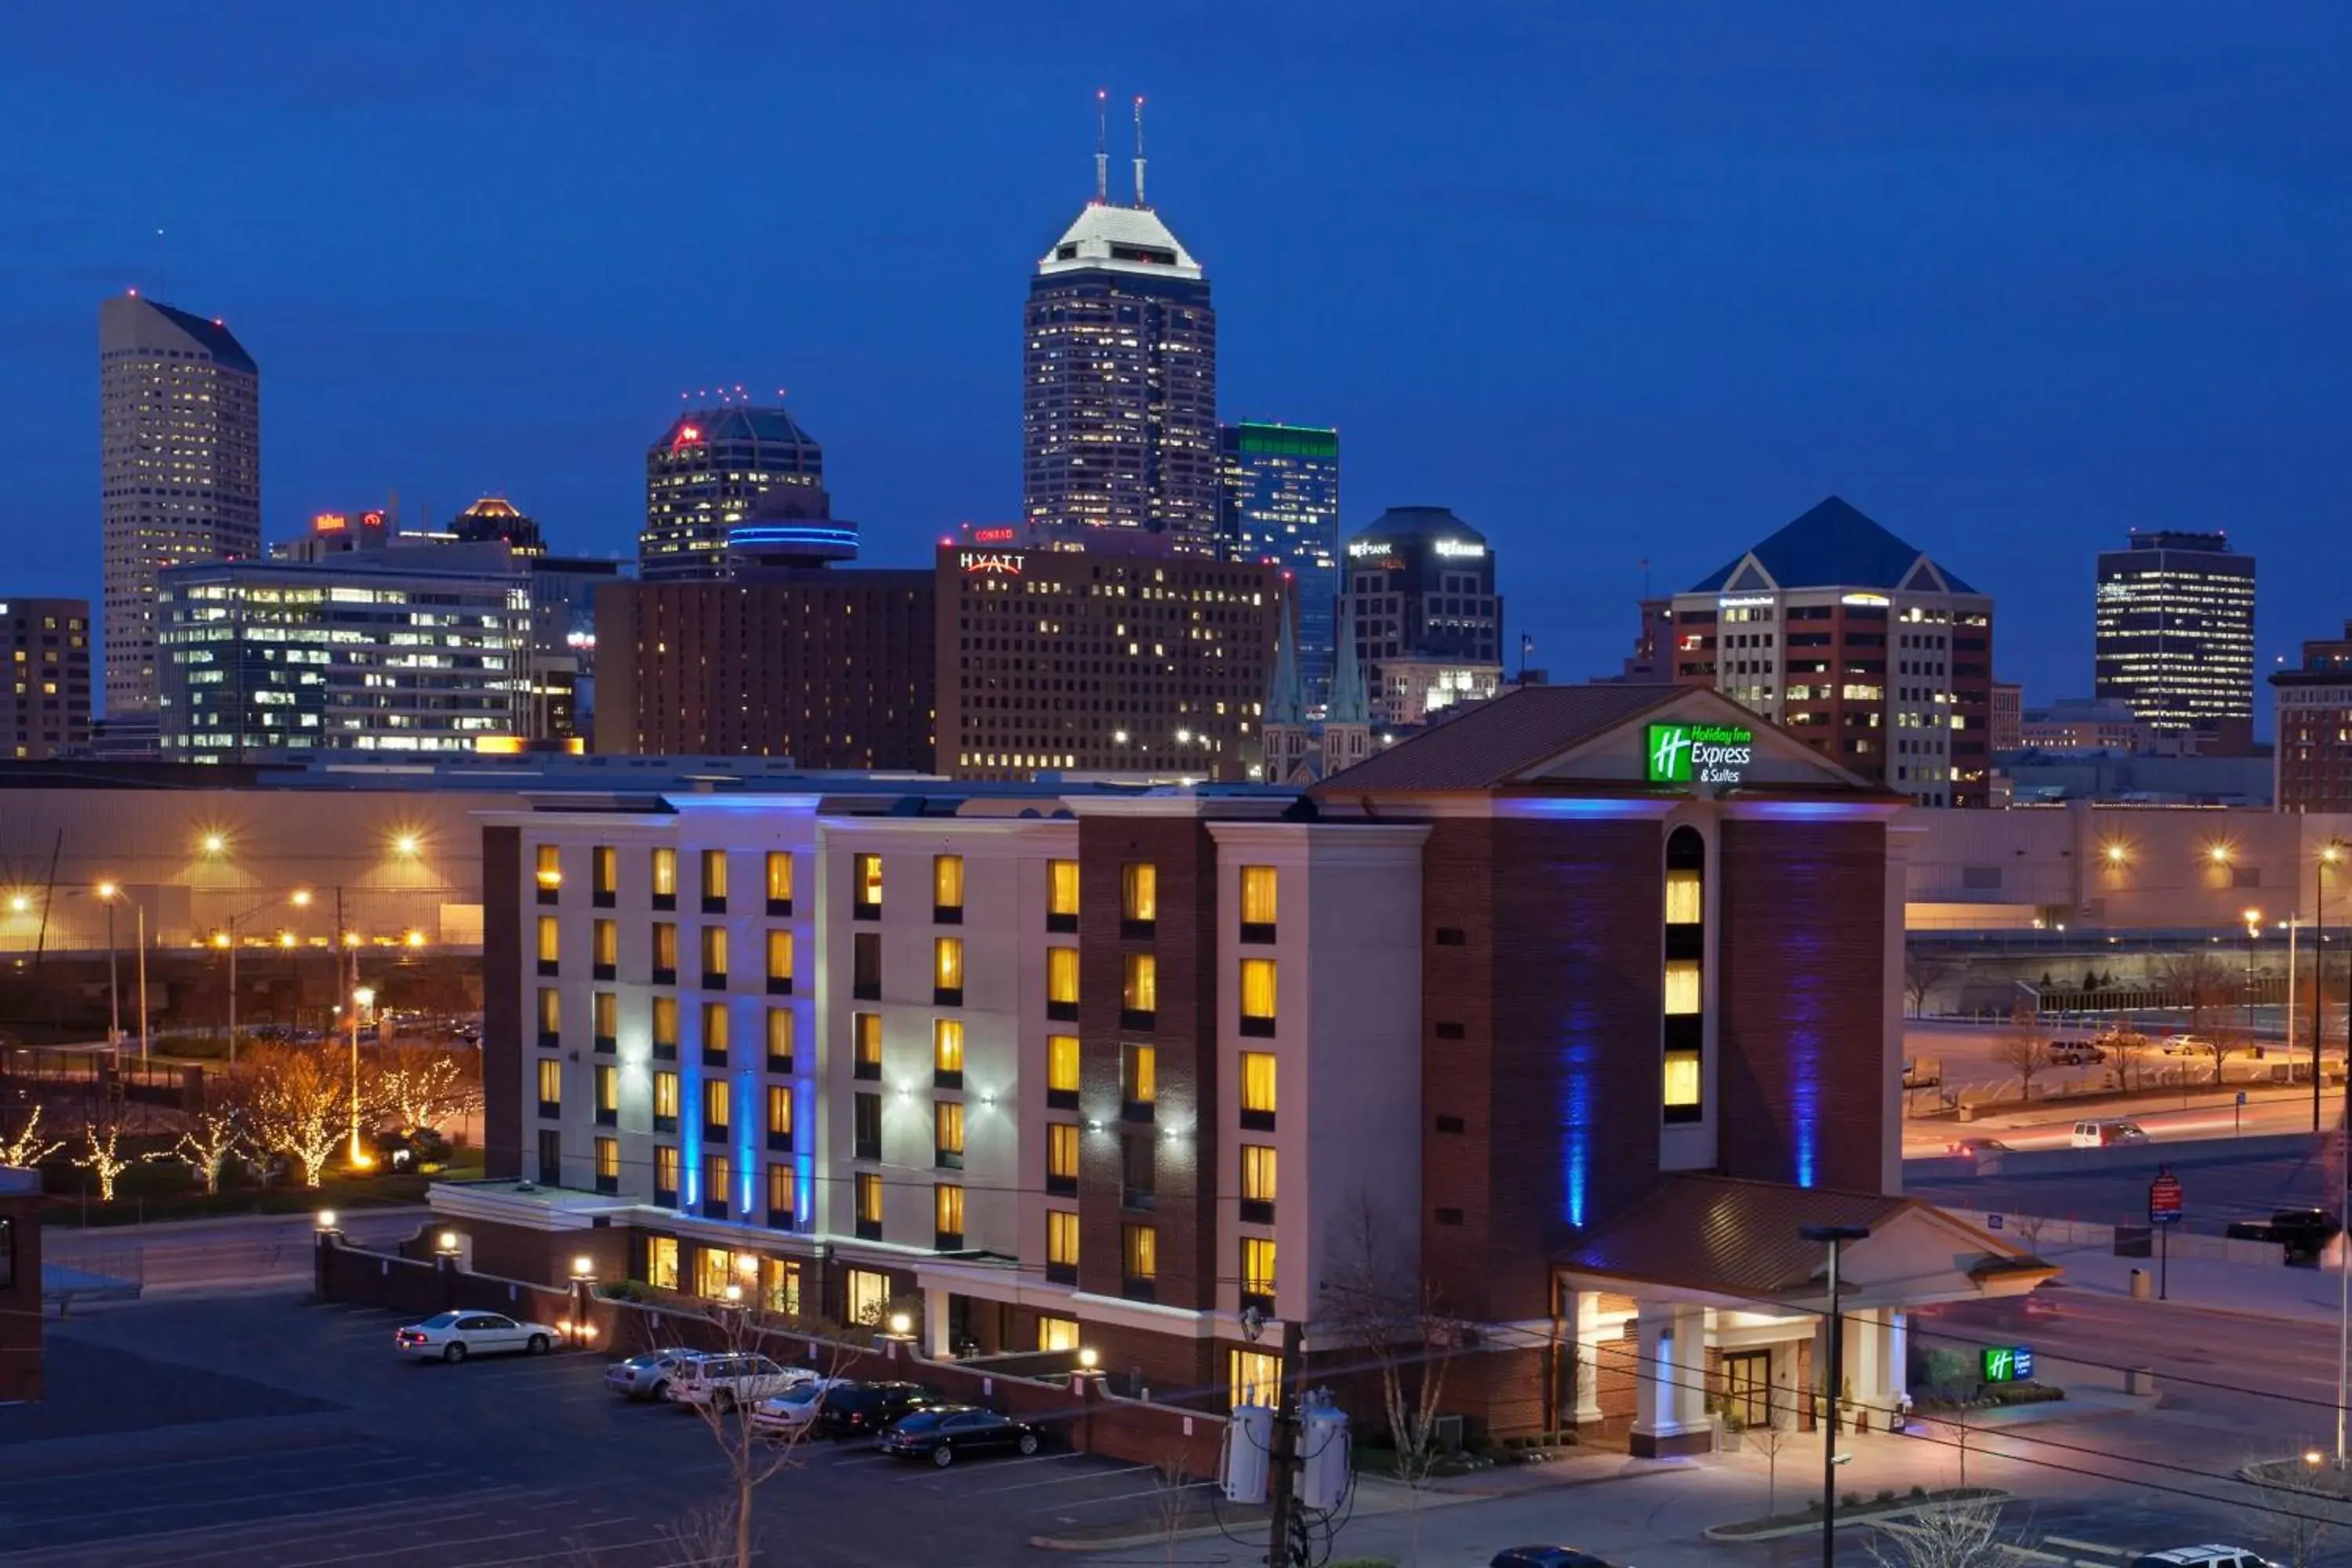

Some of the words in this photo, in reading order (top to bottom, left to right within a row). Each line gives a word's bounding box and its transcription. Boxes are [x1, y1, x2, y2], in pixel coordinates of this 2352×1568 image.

[960, 553, 1025, 573] HYATT
[1692, 726, 1732, 744] Holiday
[1733, 727, 1751, 742] Inn
[1691, 742, 1751, 767] Express
[1700, 769, 1709, 782] &
[1711, 769, 1740, 782] Suites
